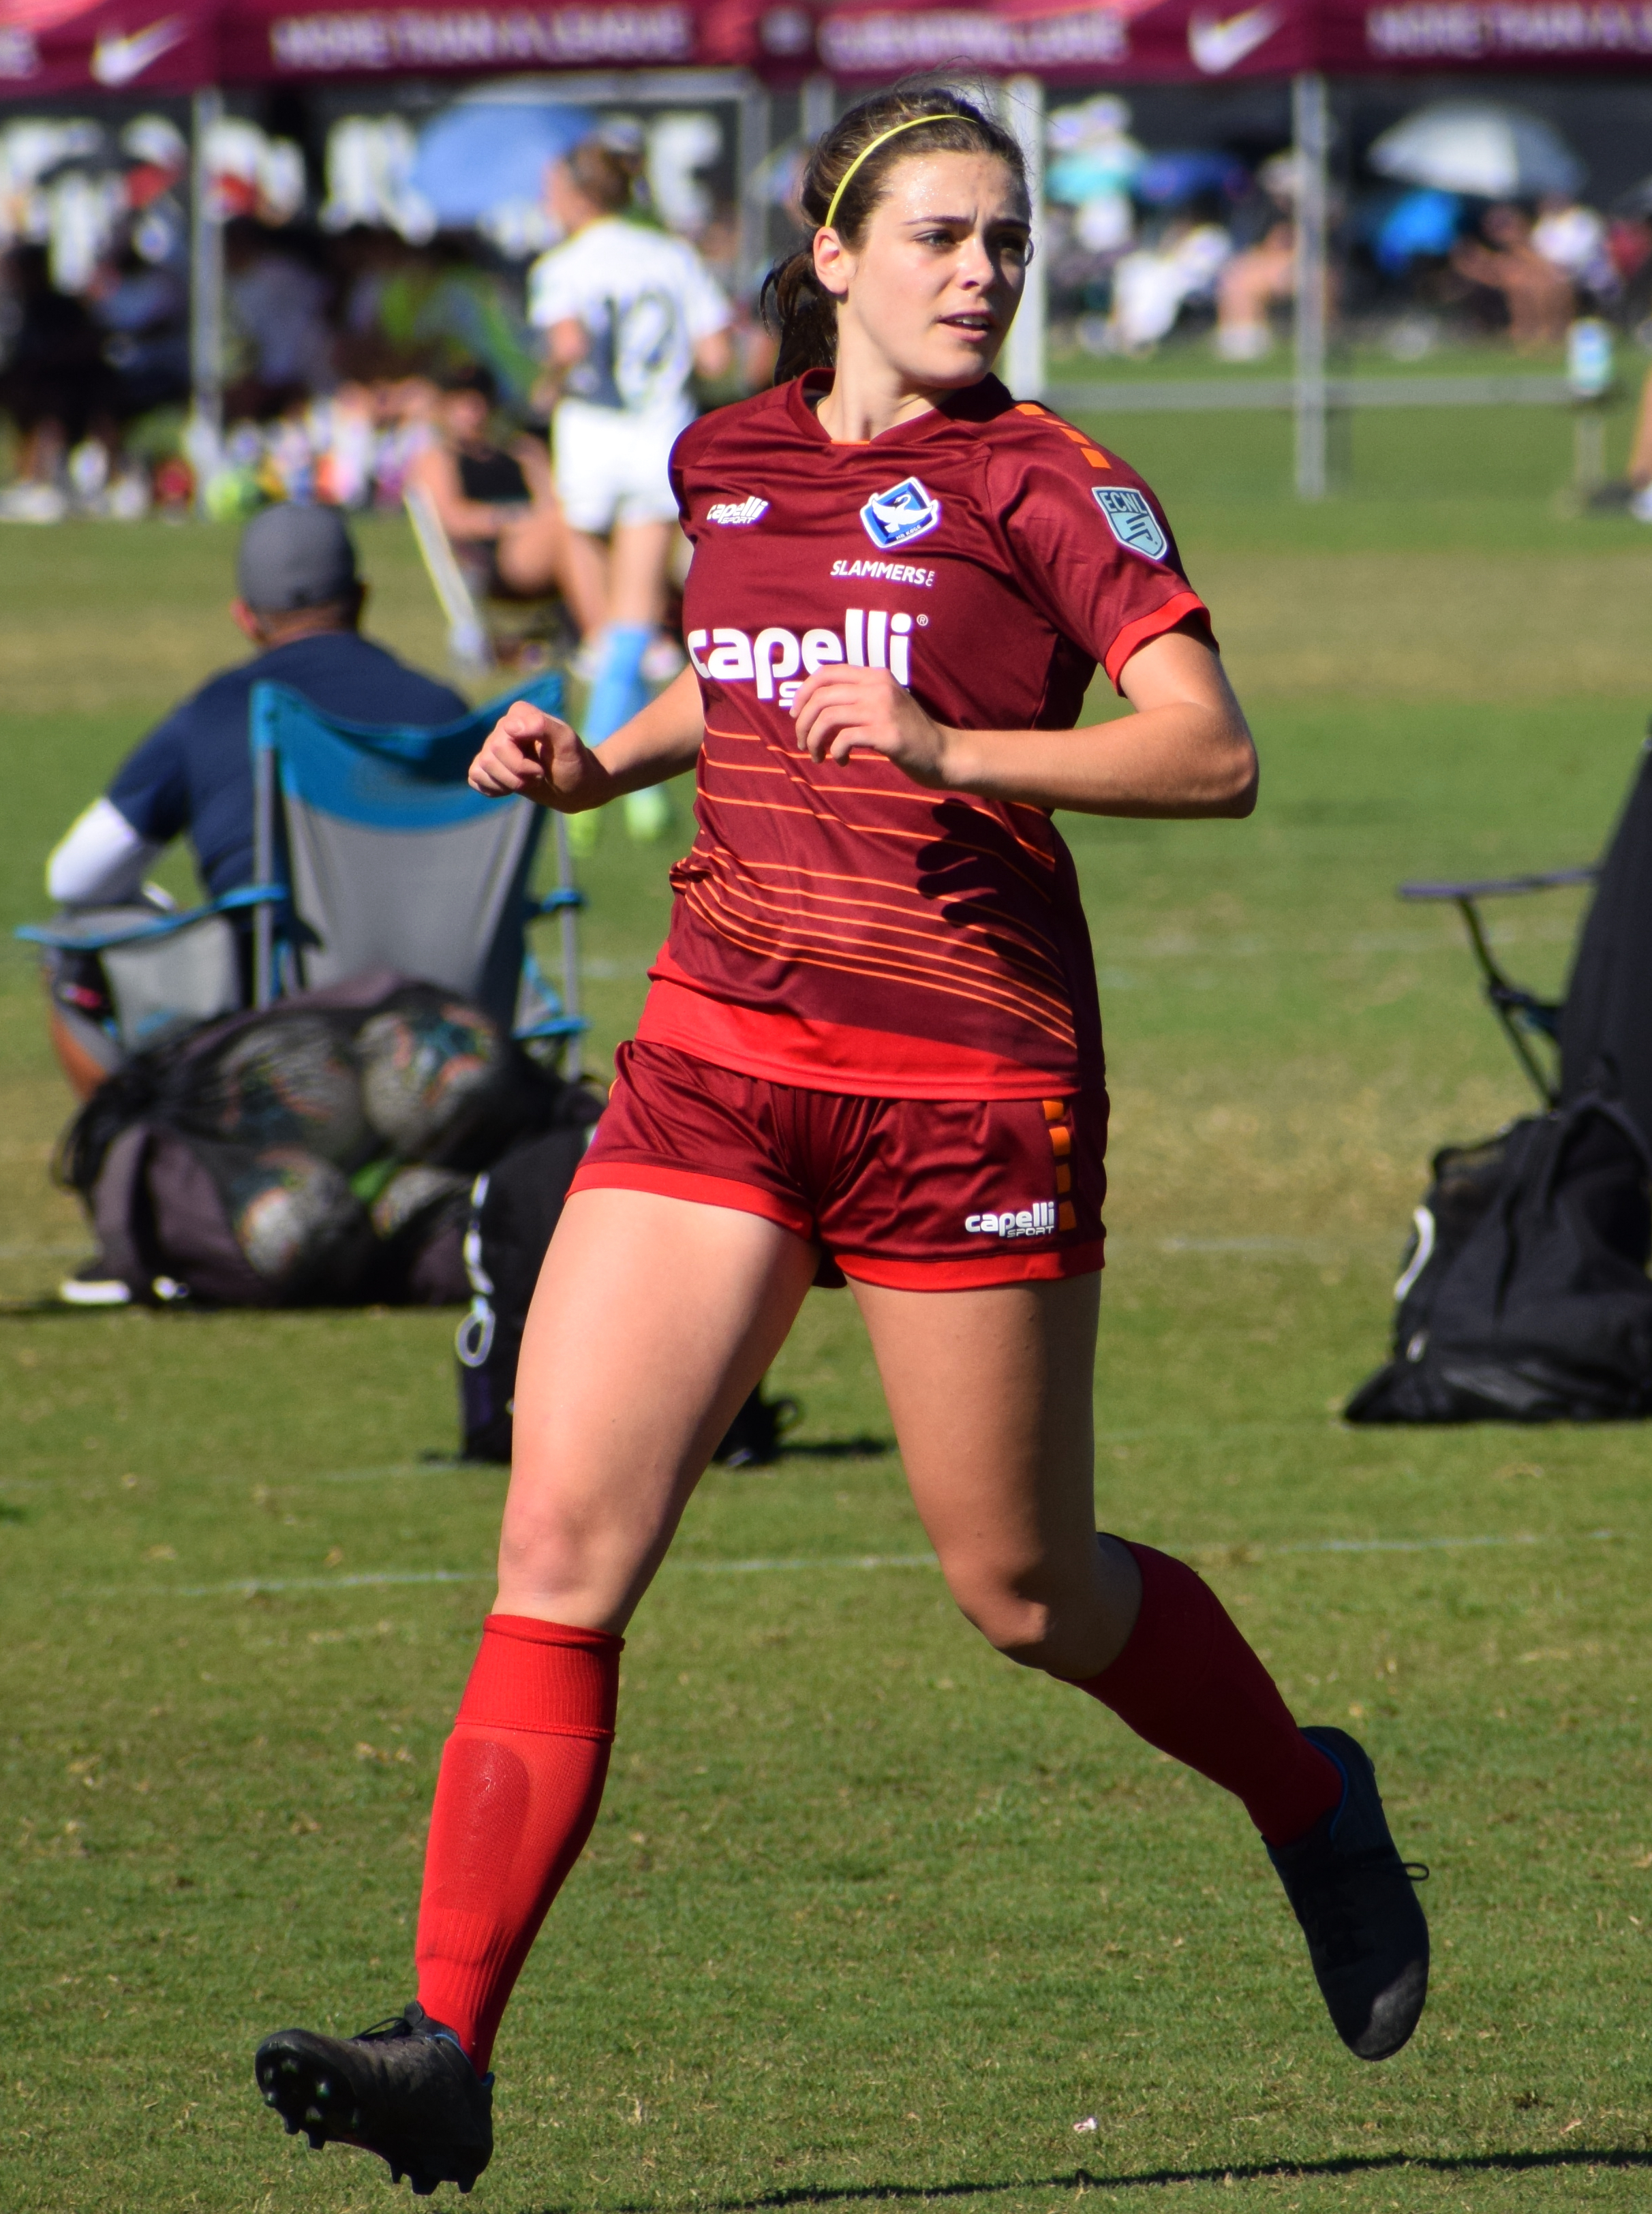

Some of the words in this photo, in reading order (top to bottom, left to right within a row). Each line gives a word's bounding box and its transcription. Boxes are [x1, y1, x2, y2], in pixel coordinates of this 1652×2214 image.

[706, 495, 769, 523] capelli
[1099, 491, 1148, 514] ECNL
[721, 516, 756, 524] SPORT
[830, 559, 926, 585] SLAMMERS
[965, 1201, 1055, 1237] capelli
[1007, 1225, 1055, 1238] SPORT
